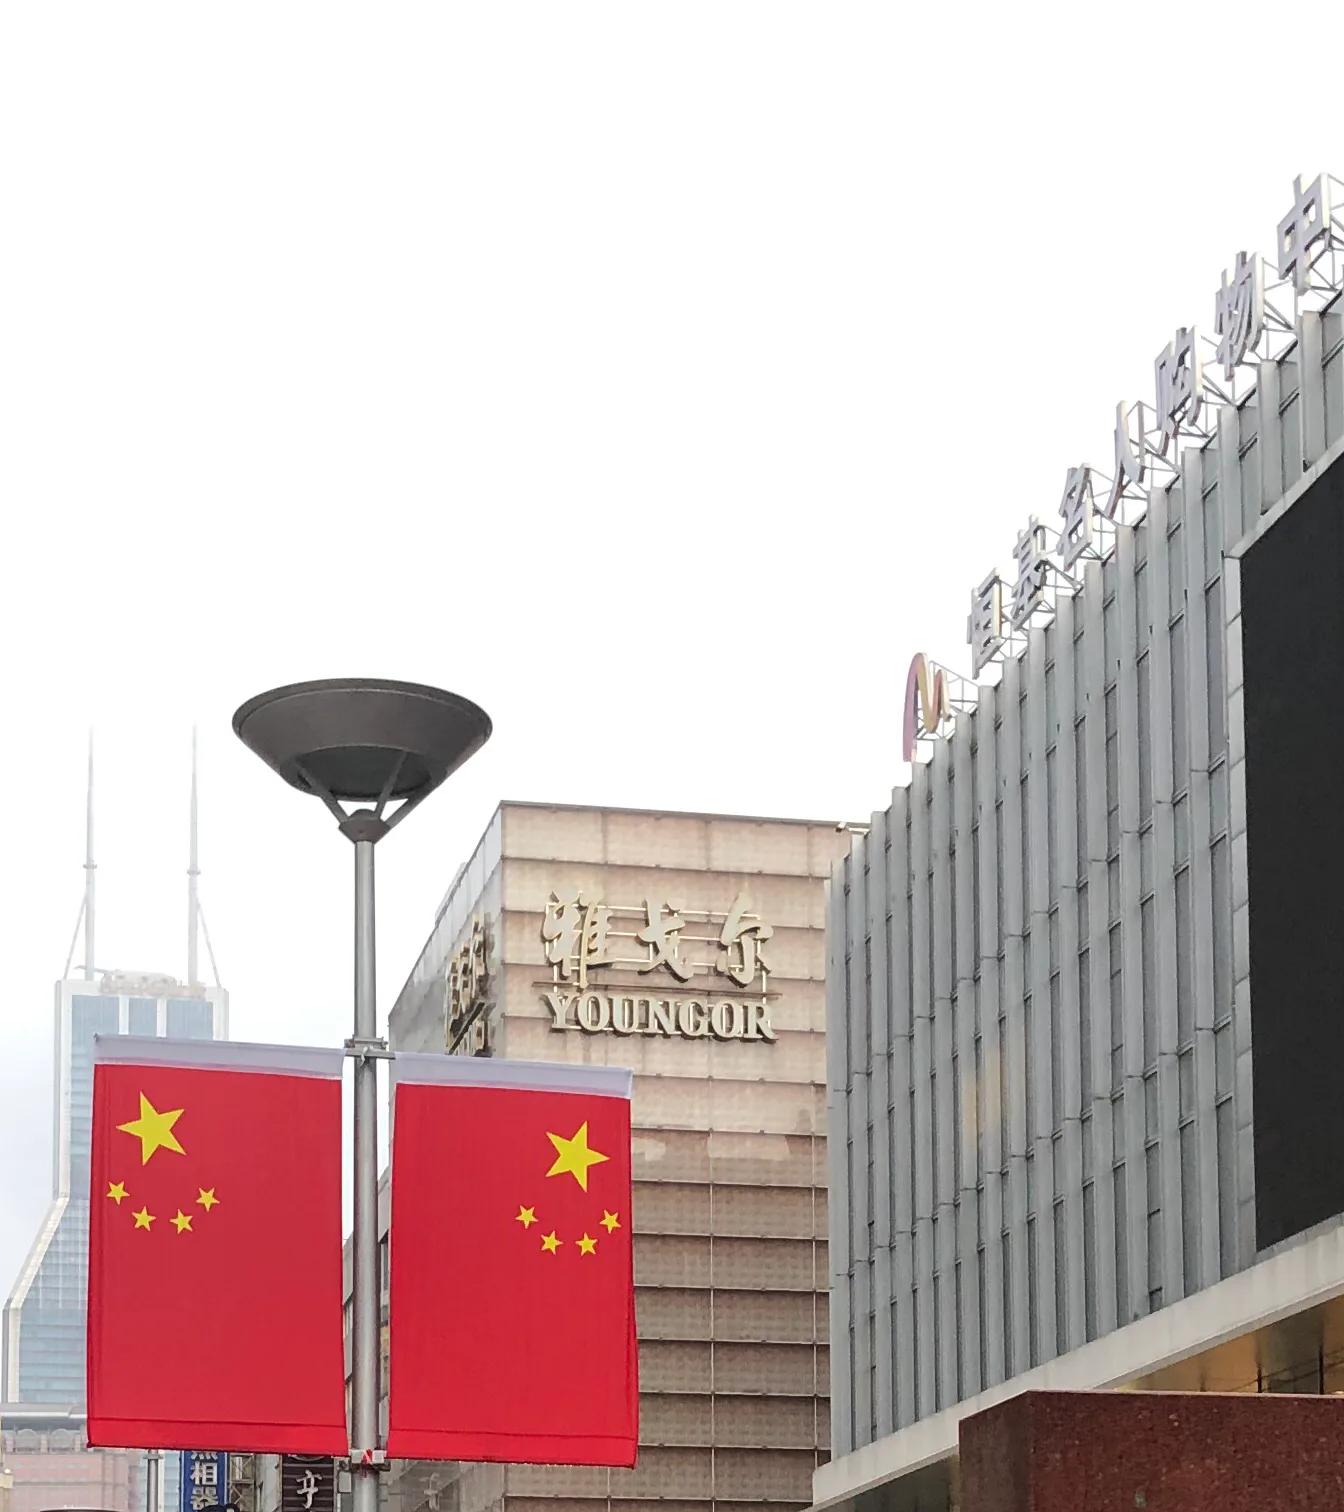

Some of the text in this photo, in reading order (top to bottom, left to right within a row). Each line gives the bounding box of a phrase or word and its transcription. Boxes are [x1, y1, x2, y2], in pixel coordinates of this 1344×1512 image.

[542, 889, 774, 989] 雅戈尔
[543, 991, 777, 1041] YOUNGOR
